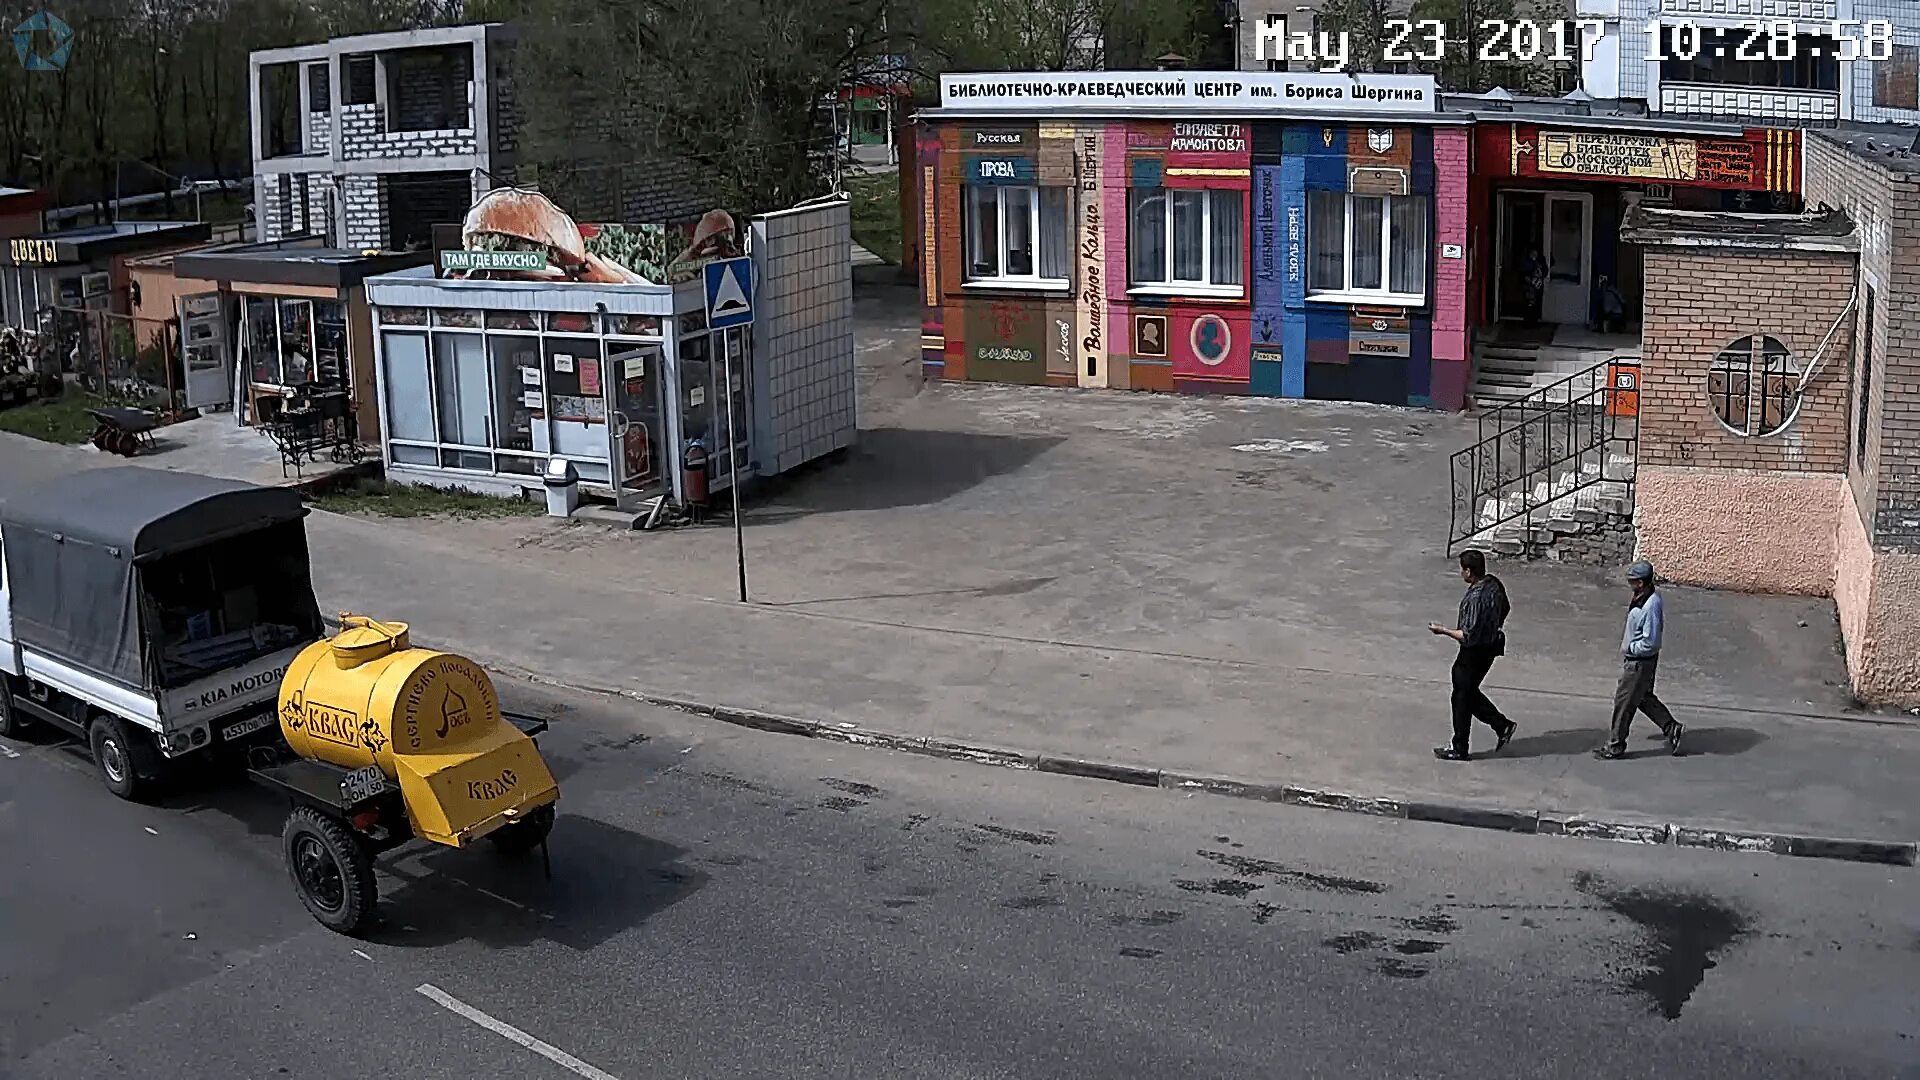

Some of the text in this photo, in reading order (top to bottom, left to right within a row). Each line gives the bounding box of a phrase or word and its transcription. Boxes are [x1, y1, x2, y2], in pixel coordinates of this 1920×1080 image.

[949, 77, 1423, 102] БИБЛИОТЕЧНО-КРАЕВЕДЧЕСКИЙ ЦЕНТР им. Бориса Шергина
[1576, 134, 1662, 147] ПЕРЕЗАГРУЗКА
[1576, 144, 1651, 157] БИБЛИОТЕК
[10, 239, 58, 267] ЦВЕТЫ
[445, 253, 542, 269] ТАМ ГДЕ ВКУСНО.
[1083, 265, 1101, 352] Волшебное
[200, 688, 228, 707] KIA
[309, 707, 354, 743] КВАС
[349, 766, 377, 788] 2470
[467, 769, 517, 801] КВАС
[352, 781, 382, 801] ОН 50
